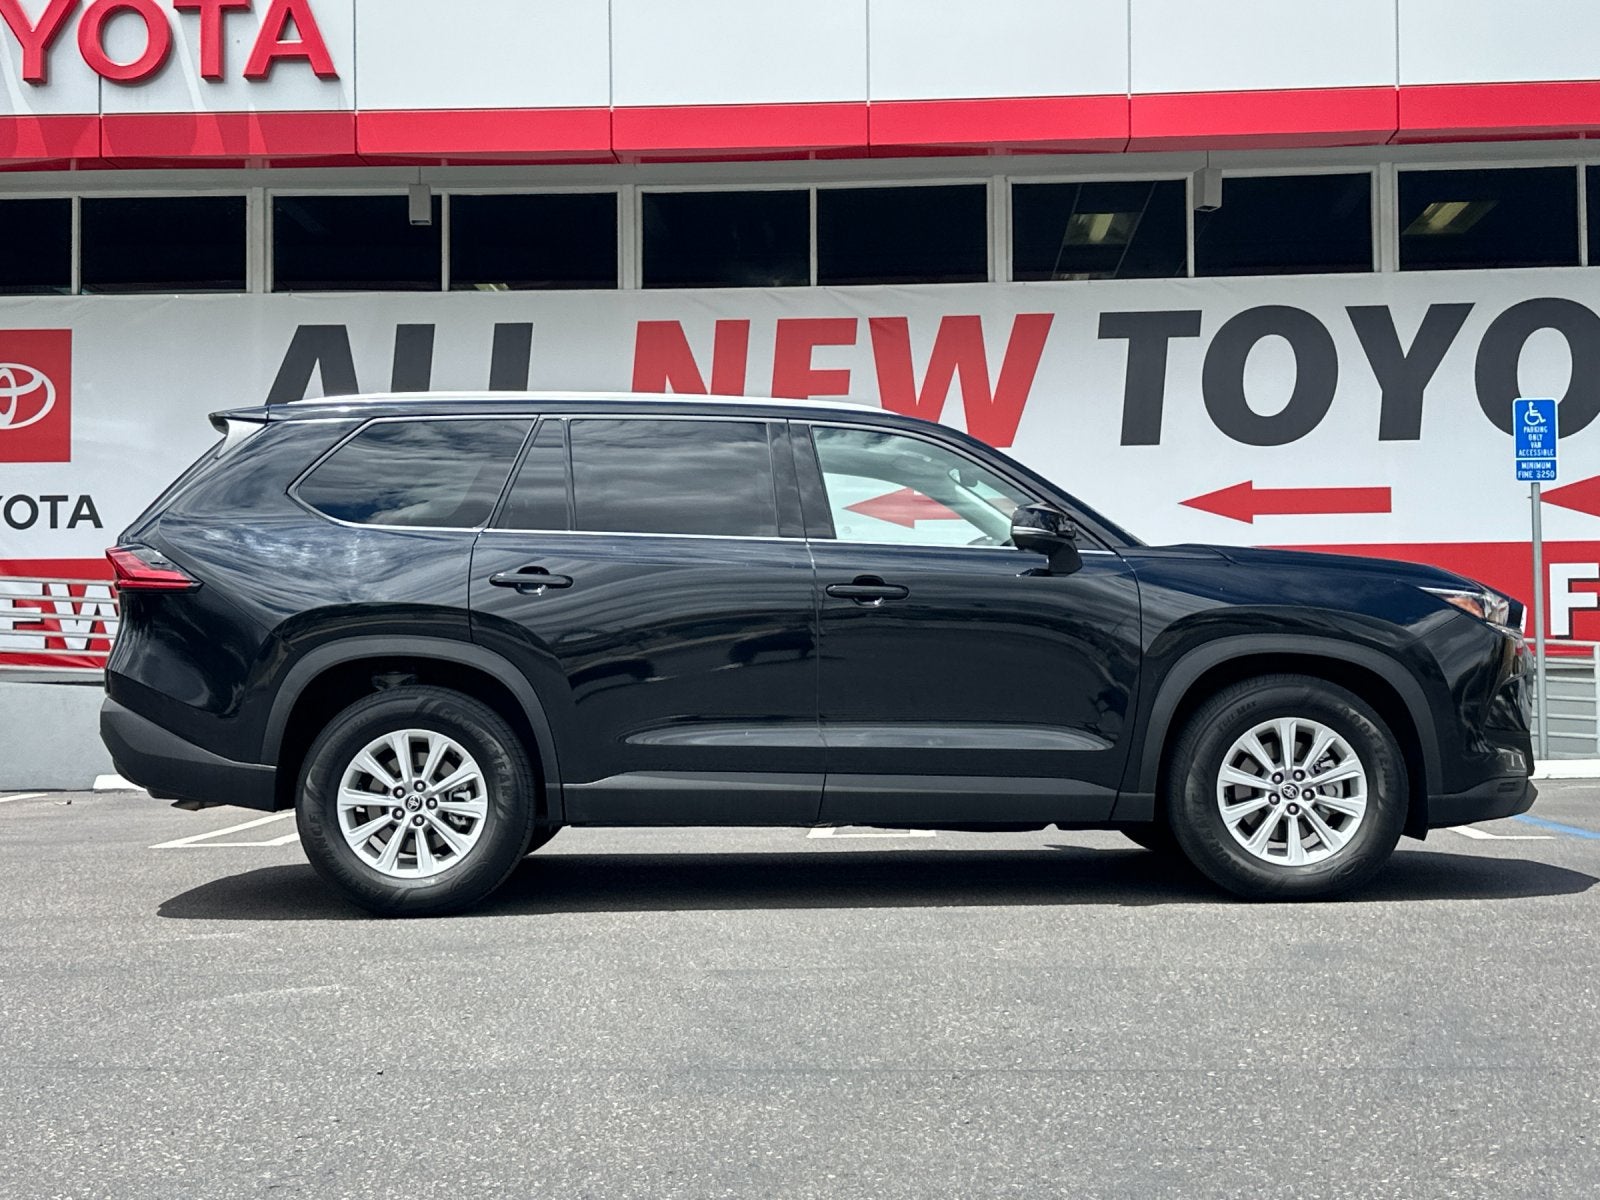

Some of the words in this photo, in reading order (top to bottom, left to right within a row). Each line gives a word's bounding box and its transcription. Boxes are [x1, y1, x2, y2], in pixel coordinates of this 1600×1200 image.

[0, 0, 340, 84] YOTA
[632, 313, 1055, 447] NEW
[1098, 297, 1600, 446] TOYO
[1518, 449, 1554, 457] ACCESSIBLE
[1517, 470, 1533, 478] FINE
[0, 494, 103, 530] OTA
